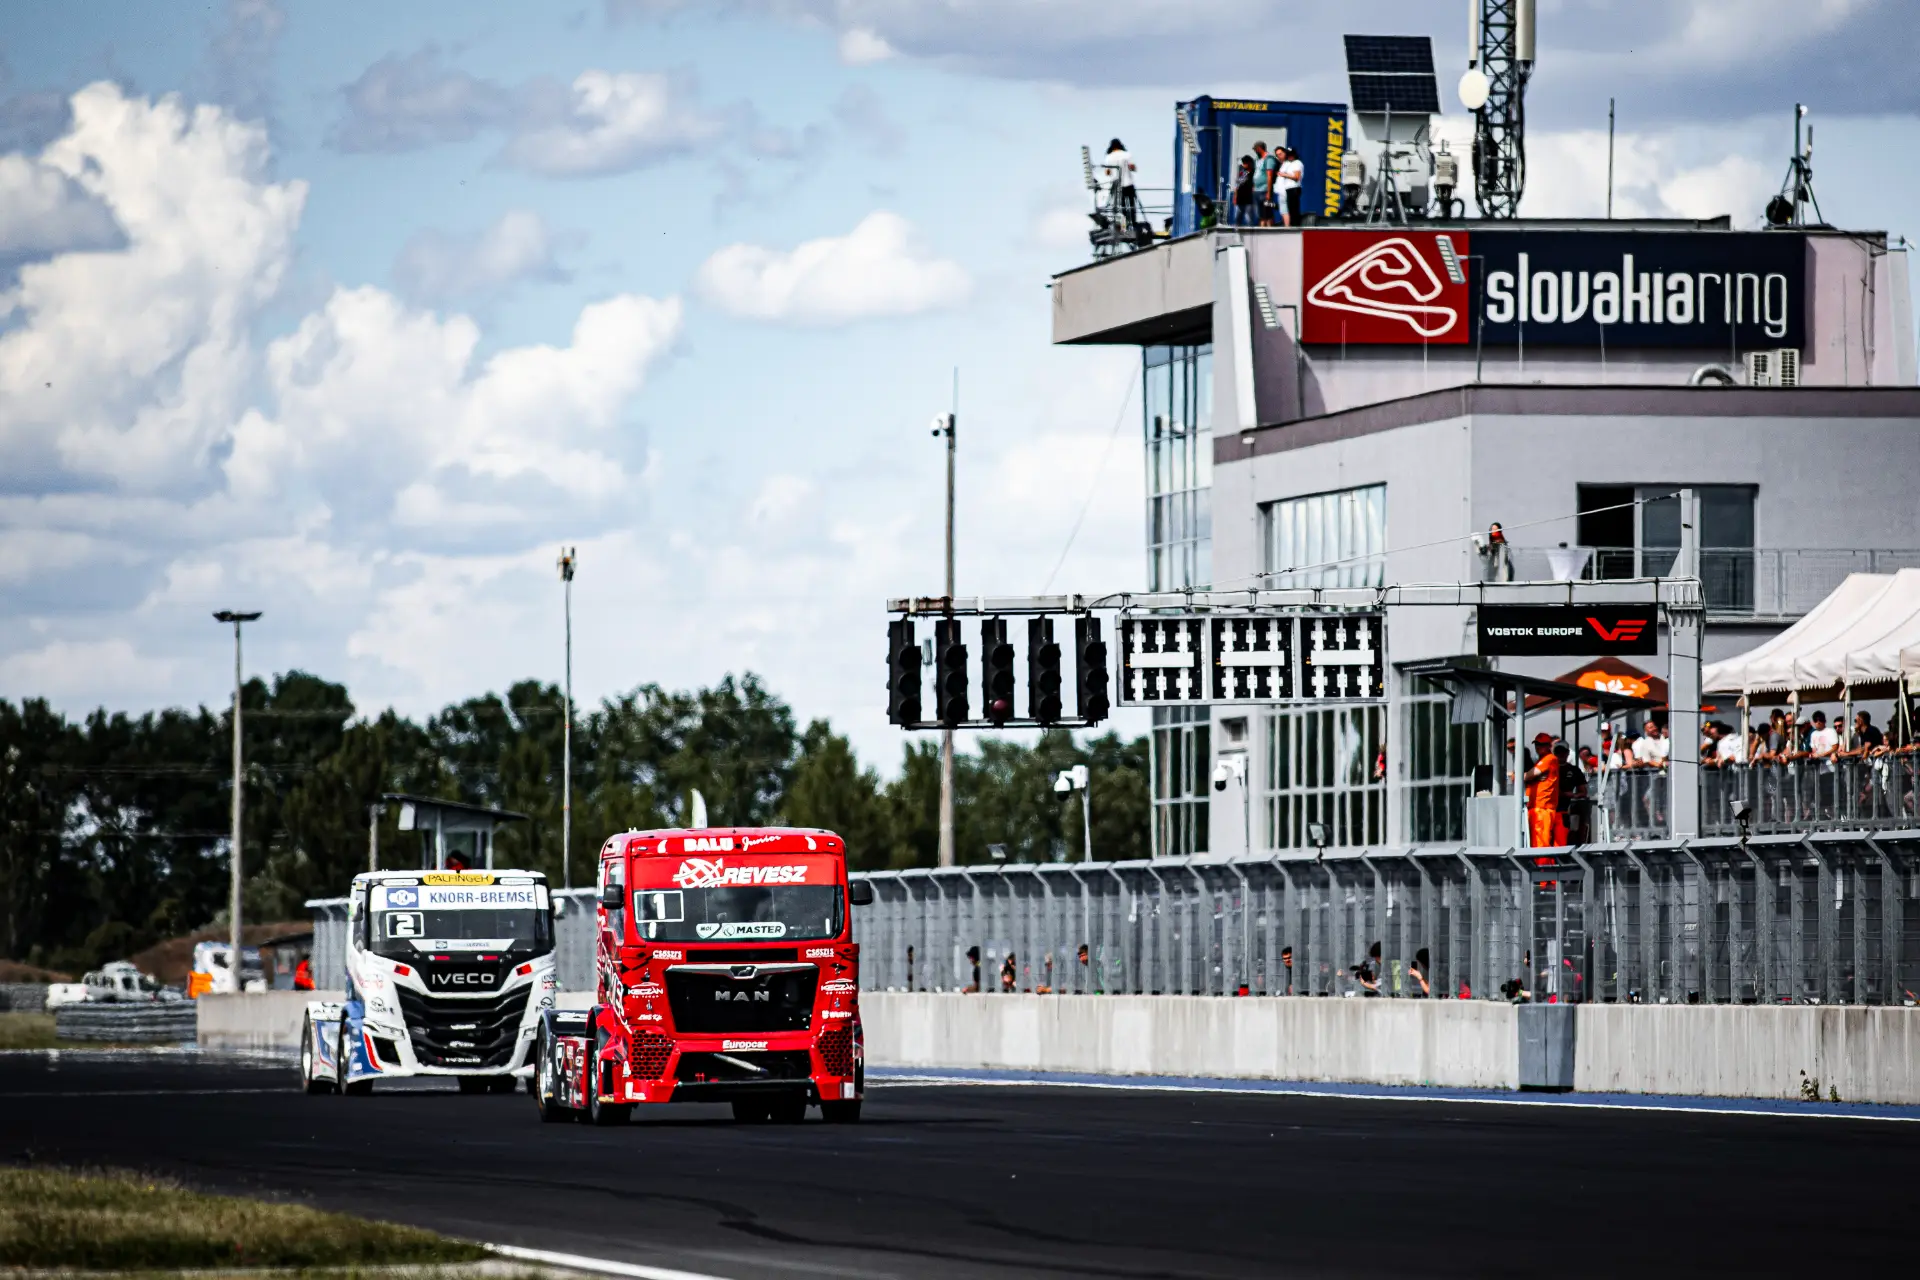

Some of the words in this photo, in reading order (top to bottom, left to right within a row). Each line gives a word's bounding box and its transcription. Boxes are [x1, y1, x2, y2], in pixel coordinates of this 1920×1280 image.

[1324, 117, 1344, 217] ONTAINEX
[1486, 252, 1788, 338] slovakiaring
[1487, 627, 1534, 636] VOSTOK
[1537, 627, 1583, 636] EUROPE
[684, 837, 734, 852] BALU
[428, 874, 489, 883] PALFINGER
[430, 891, 534, 903] KNORR-BREMSE
[653, 894, 667, 920] 1
[396, 914, 415, 936] 2
[736, 925, 782, 934] MASTER
[431, 973, 495, 985] IVECO
[715, 990, 770, 1001] MAN
[722, 1039, 769, 1049] Europcar
